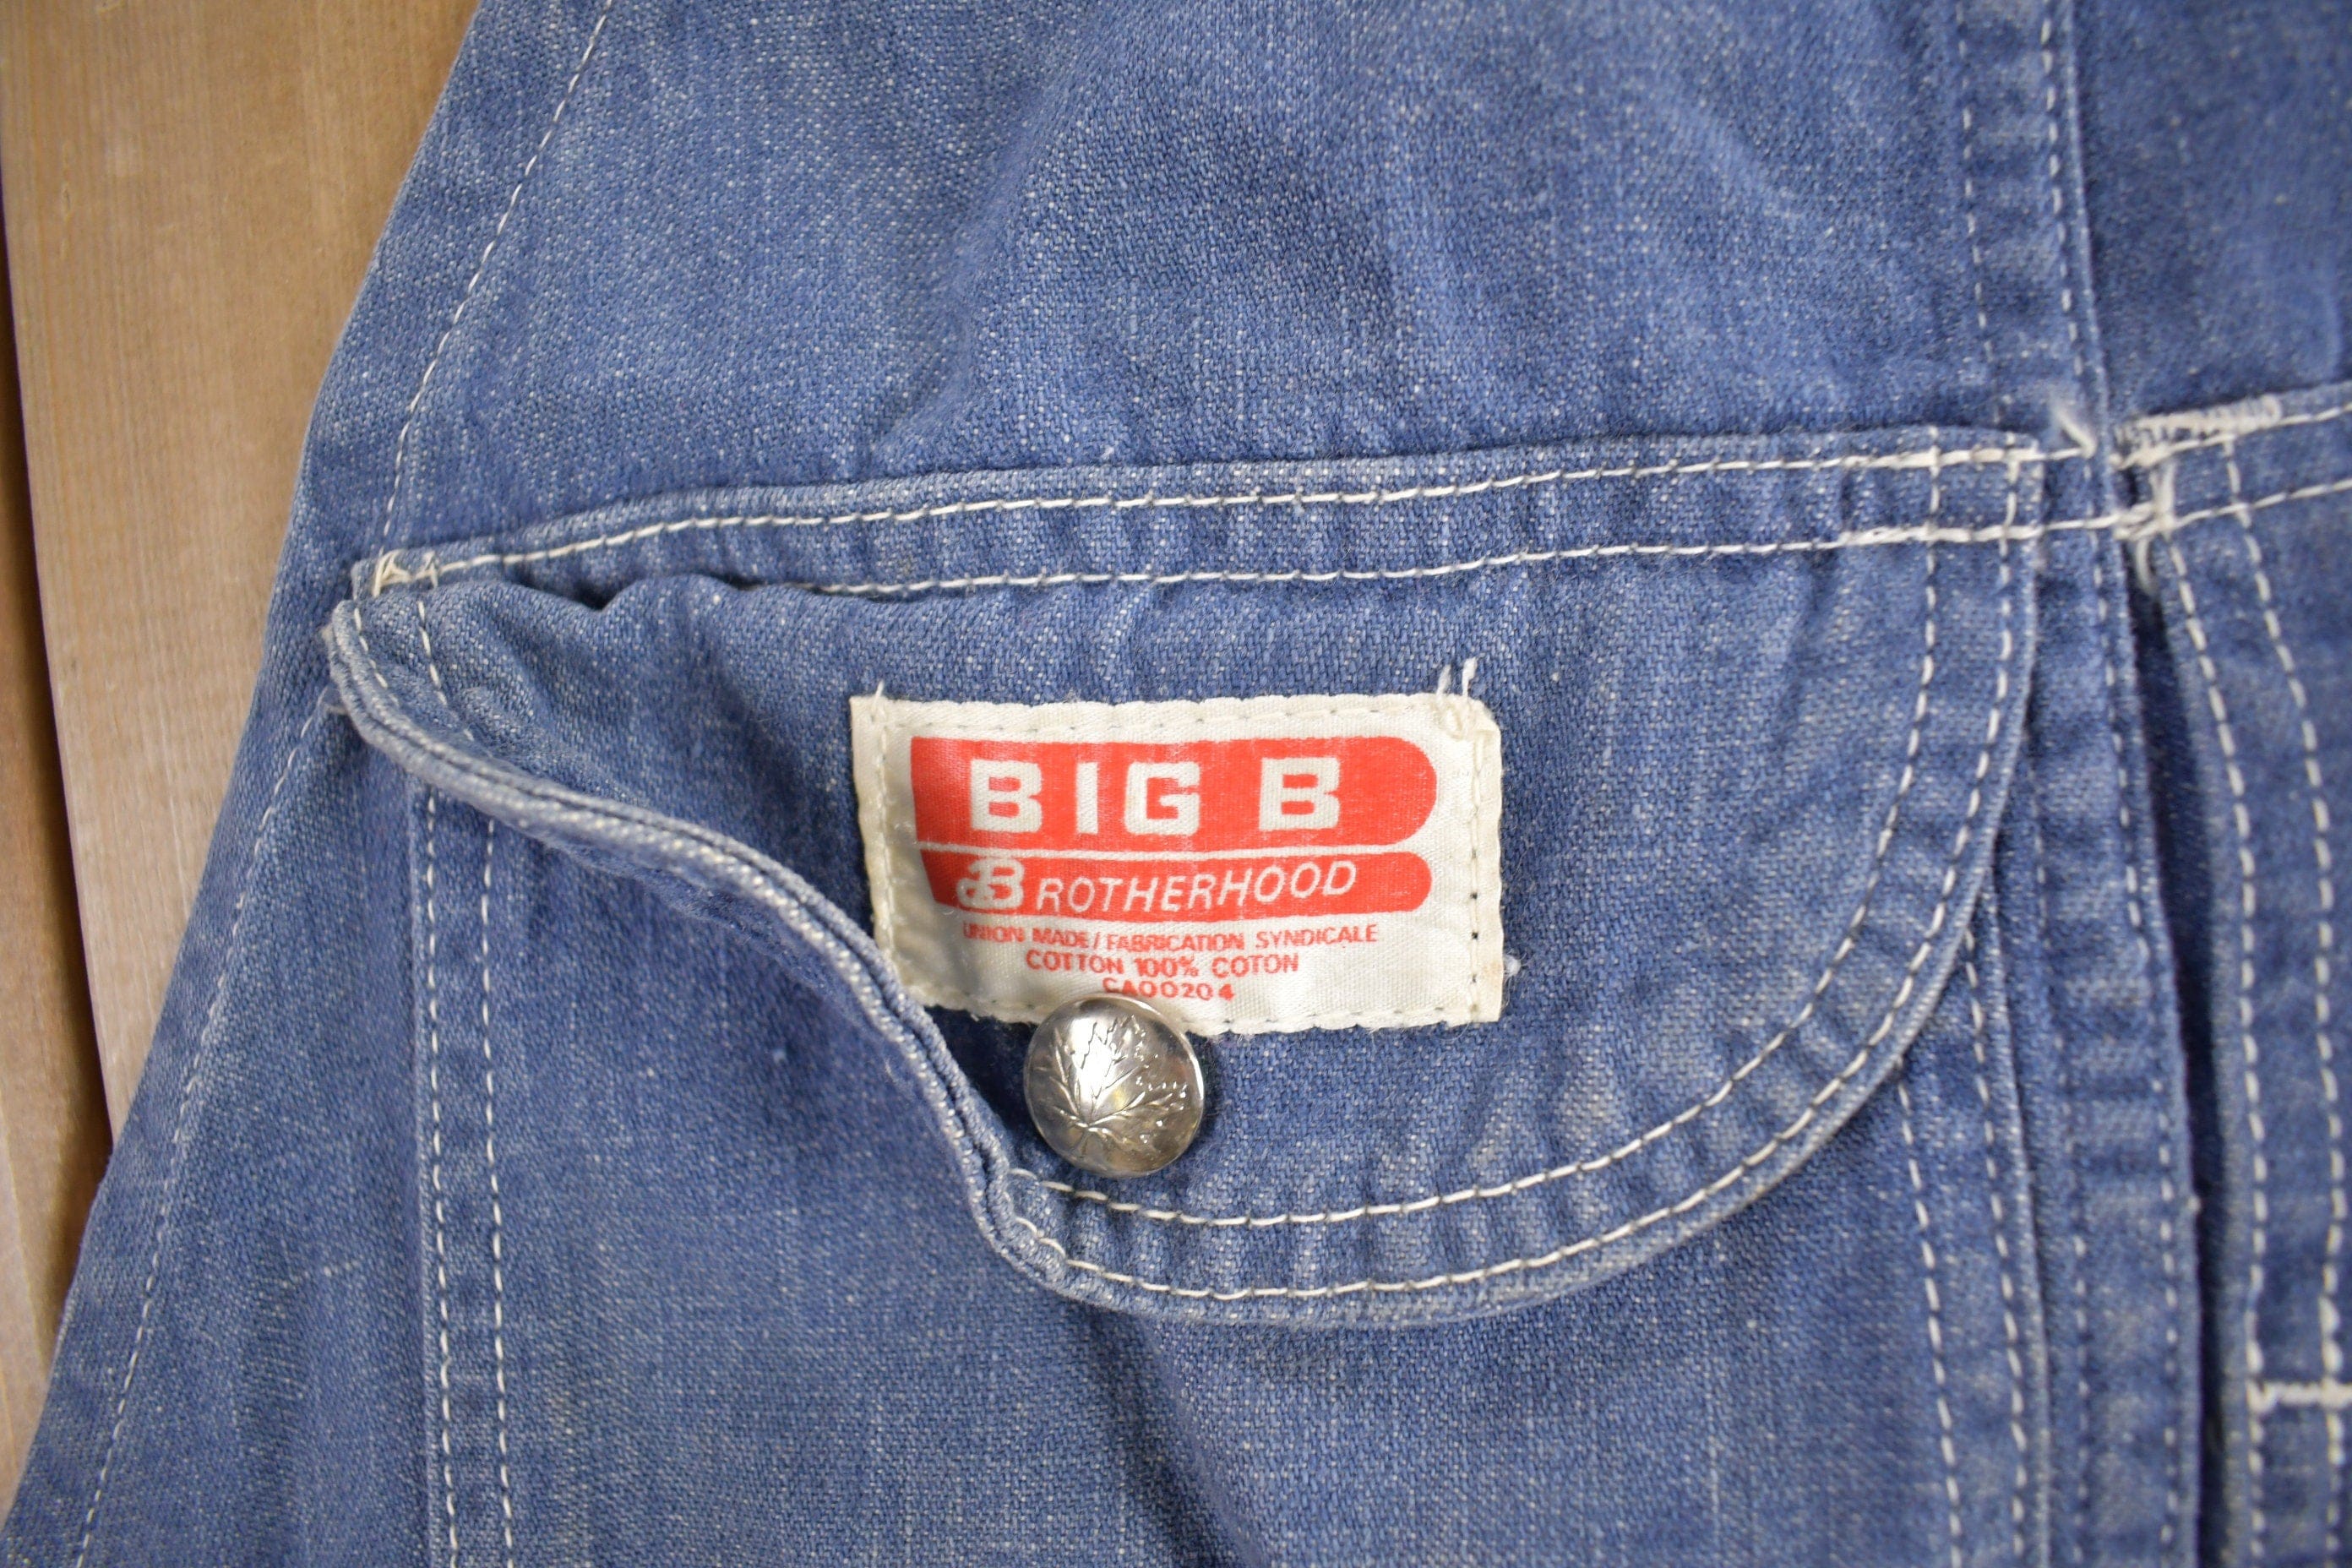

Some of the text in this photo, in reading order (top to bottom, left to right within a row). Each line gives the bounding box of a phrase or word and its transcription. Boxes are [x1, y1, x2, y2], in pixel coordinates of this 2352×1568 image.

[971, 757, 1339, 836] BIG B
[956, 858, 1356, 912] BROTHERHOOD
[963, 923, 1025, 943] UNION
[1256, 924, 1379, 949] SYNDICALE
[1026, 950, 1298, 977] COTTON 100% COTON
